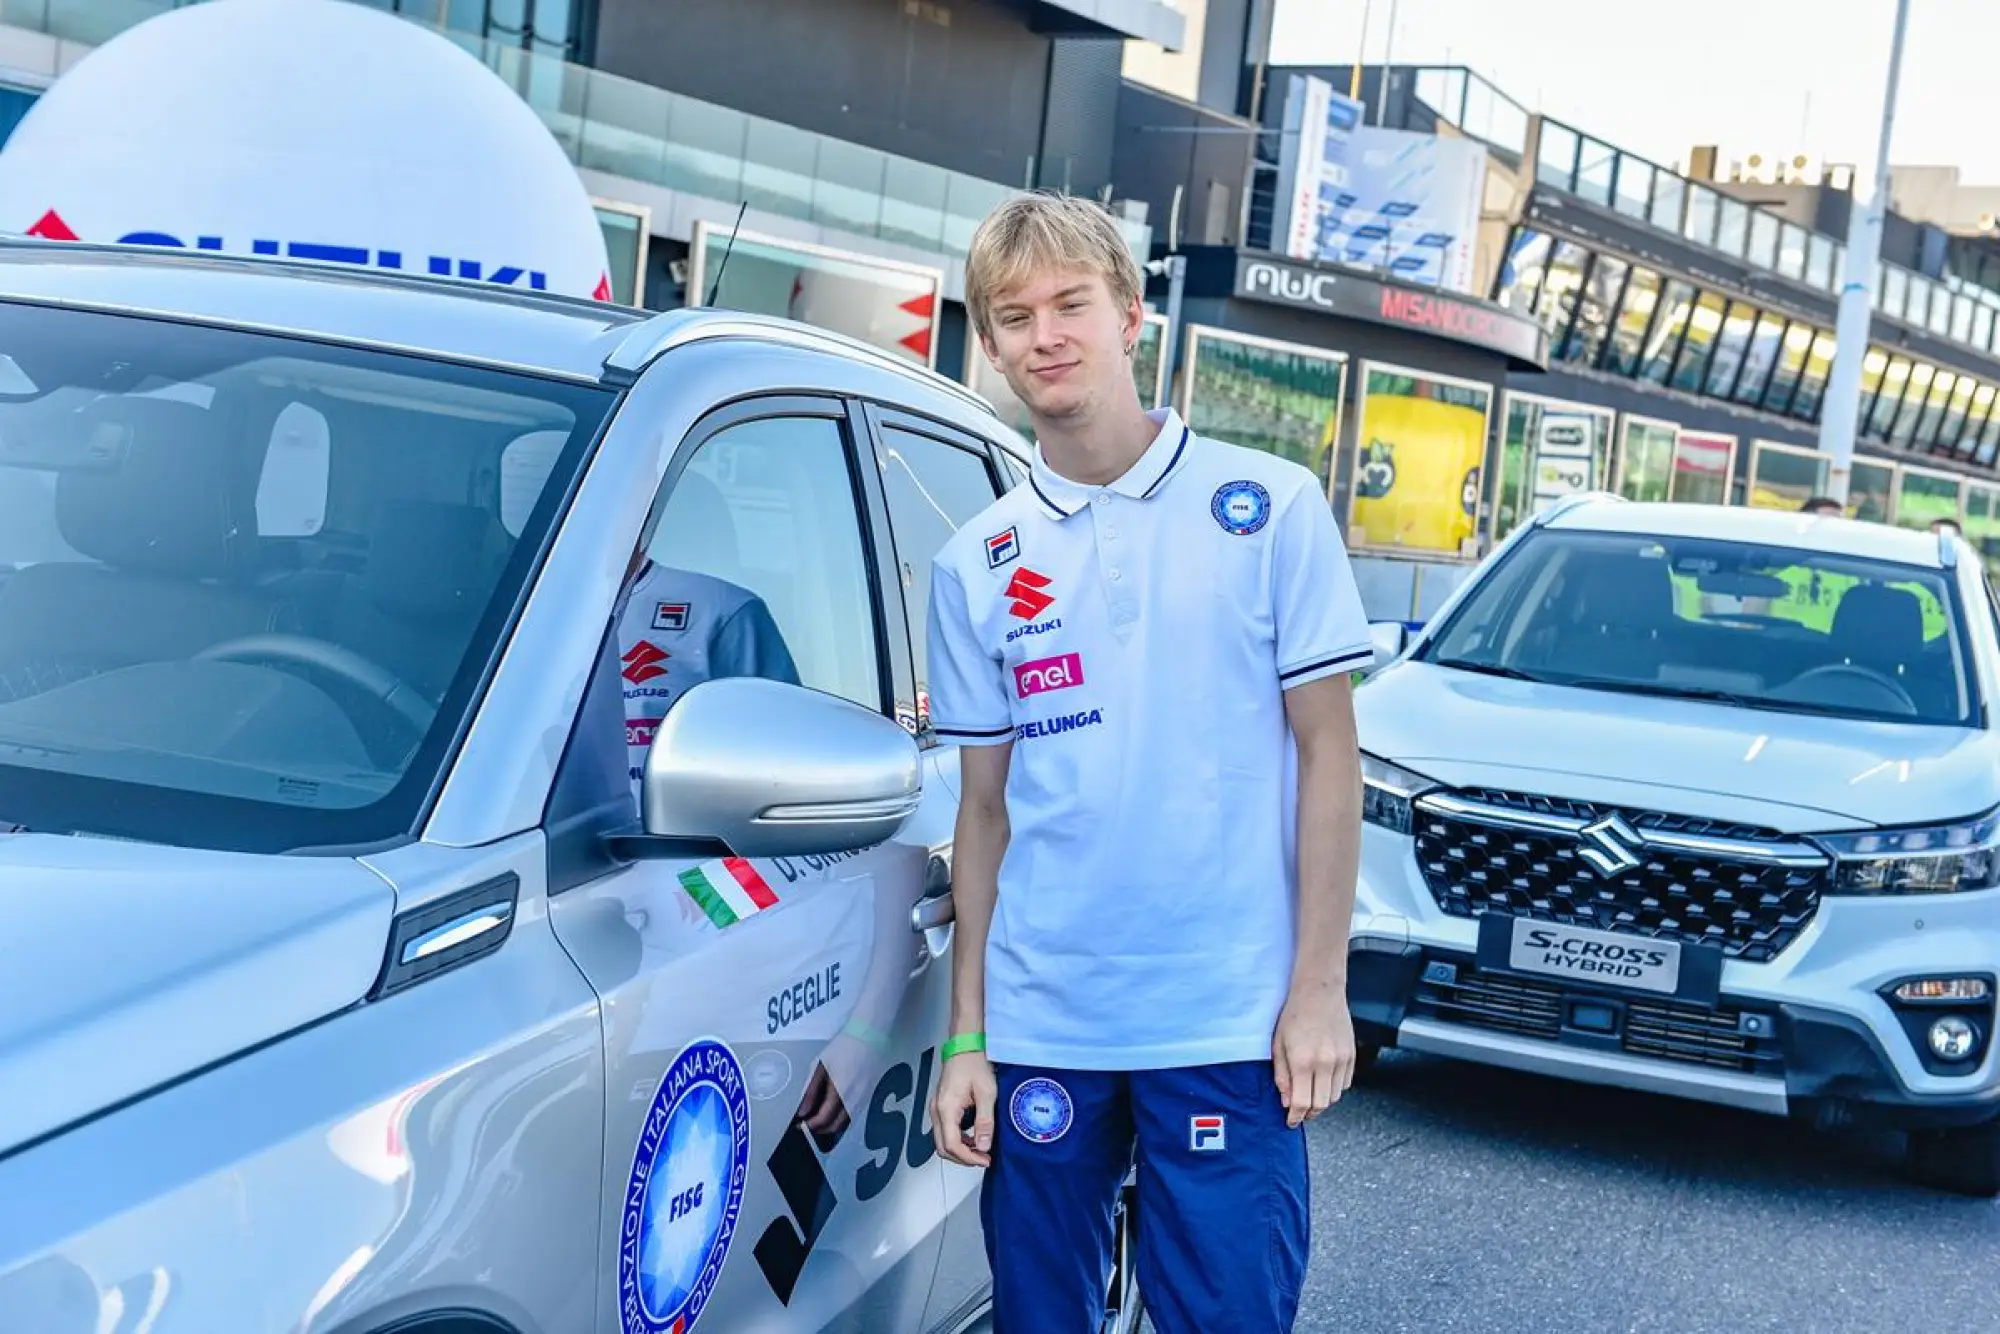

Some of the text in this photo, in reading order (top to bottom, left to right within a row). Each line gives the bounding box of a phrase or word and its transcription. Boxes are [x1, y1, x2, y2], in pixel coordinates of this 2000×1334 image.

[1006, 618, 1062, 642] SUZUKI
[1020, 657, 1073, 693] enel
[1543, 953, 1642, 978] HYBRID
[767, 962, 841, 1035] SCEGLIE
[705, 1049, 741, 1098] SPORT
[643, 1051, 702, 1152] ITALIANA
[735, 1097, 747, 1152] DEL
[668, 1181, 704, 1224] FISG
[690, 1163, 746, 1315] GHIACCIO
